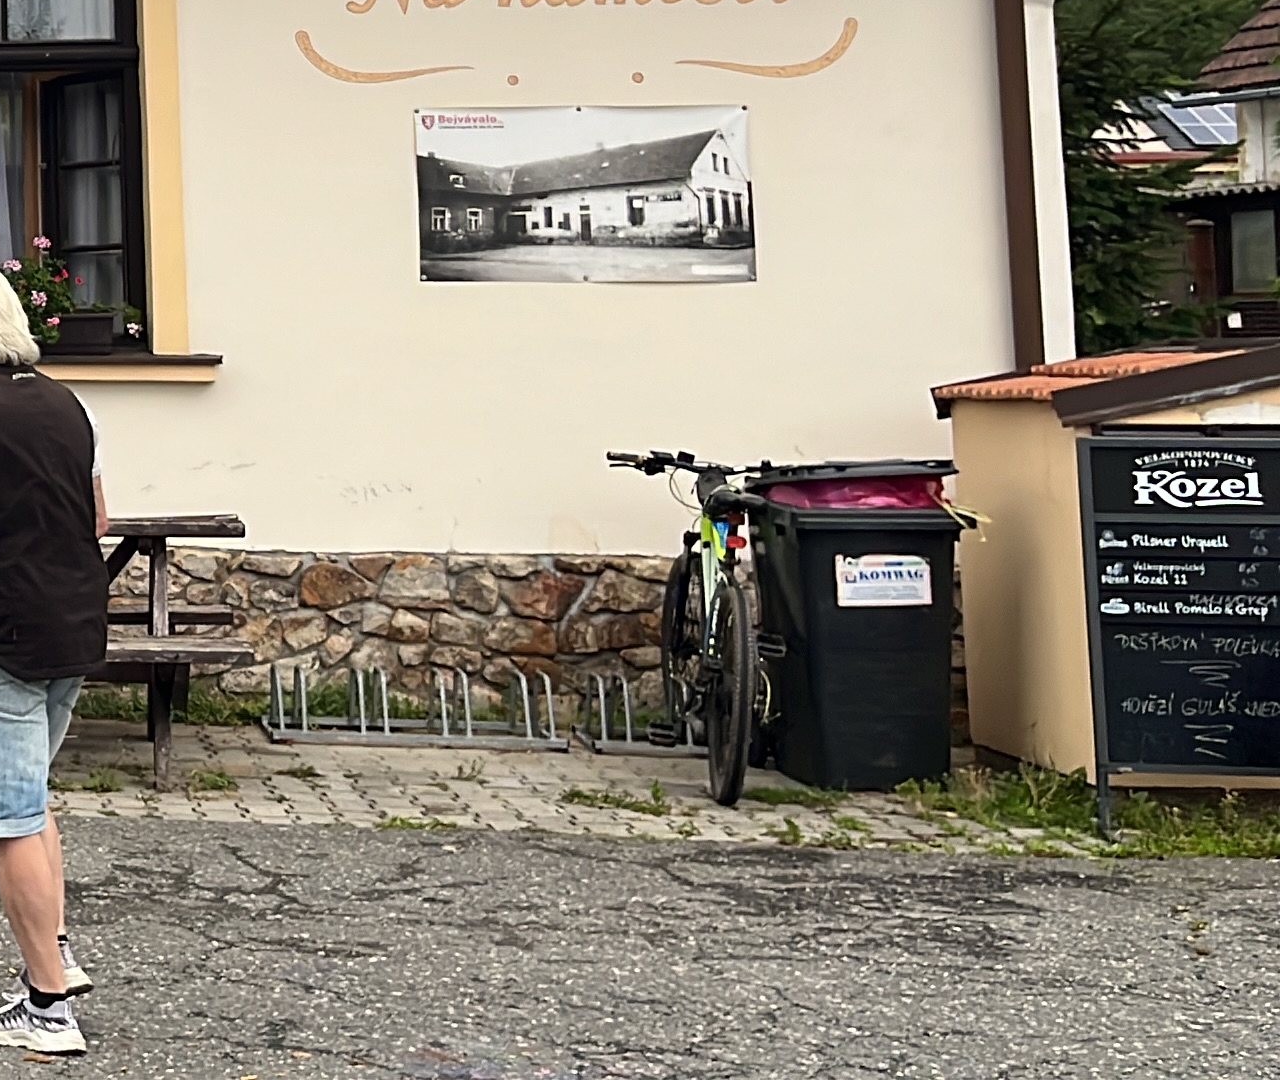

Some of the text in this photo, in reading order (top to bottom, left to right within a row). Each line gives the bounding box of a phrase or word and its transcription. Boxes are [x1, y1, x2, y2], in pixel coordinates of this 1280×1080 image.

[1134, 451, 1256, 467] VELKOPOPOVICKÝ
[1184, 459, 1209, 467] 1874
[1132, 470, 1263, 508] Kozel
[1131, 534, 1177, 547] Pilsner
[1181, 534, 1229, 553] Urquell
[859, 569, 924, 580] KOMWAG
[1133, 561, 1206, 576] Velkopopovický
[1133, 573, 1168, 585] Kozel
[1174, 573, 1188, 585] 11
[1134, 602, 1170, 614] Birell
[1175, 602, 1223, 614] Pomelo
[1224, 602, 1233, 615] &
[1234, 602, 1269, 622] Grep
